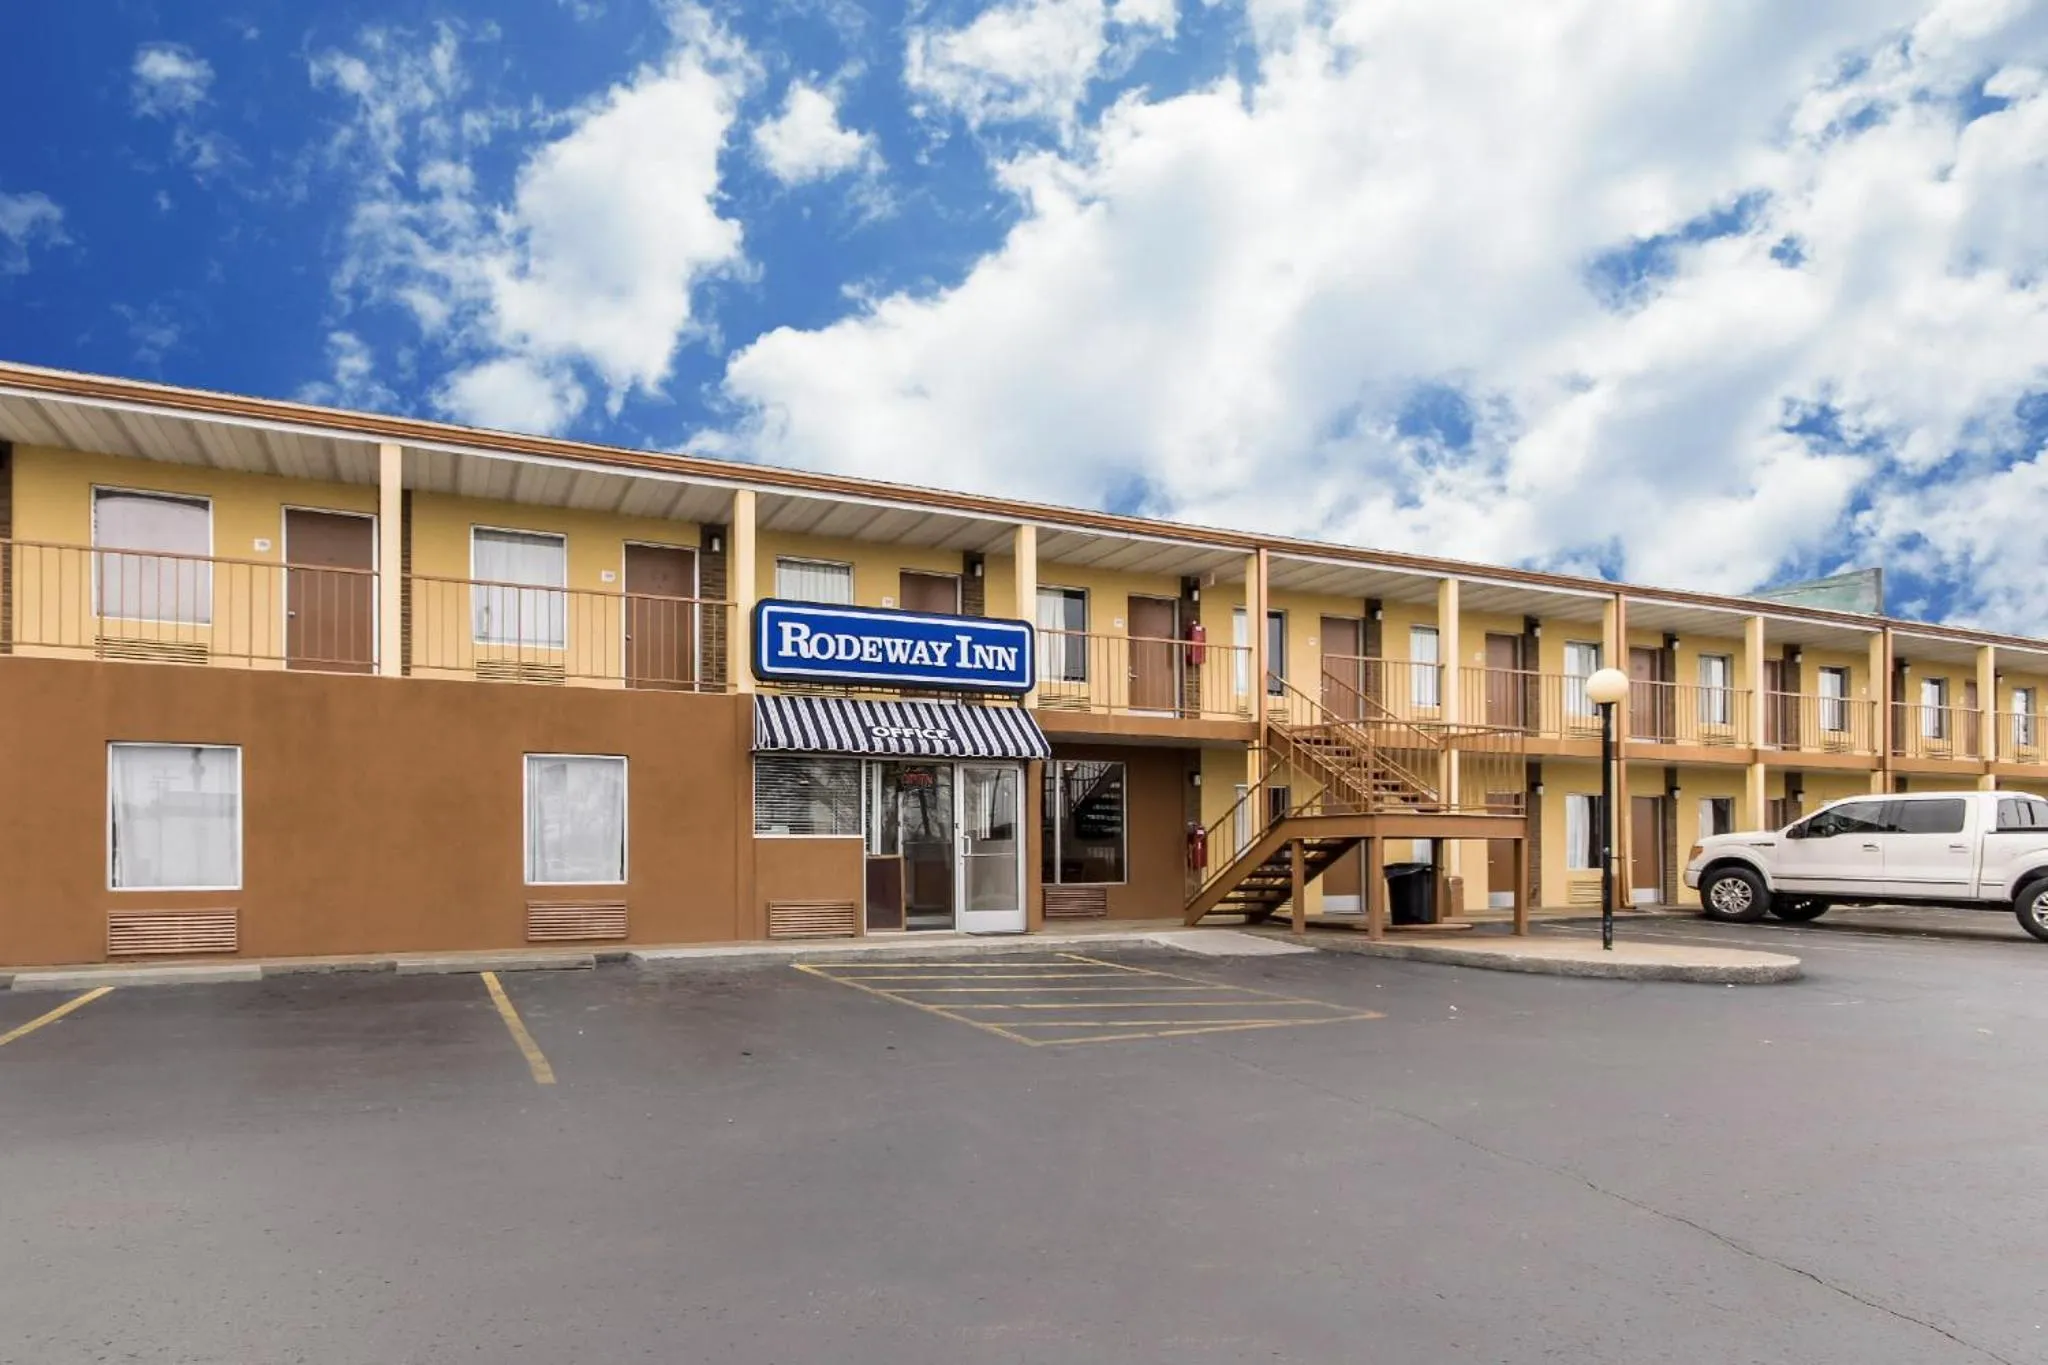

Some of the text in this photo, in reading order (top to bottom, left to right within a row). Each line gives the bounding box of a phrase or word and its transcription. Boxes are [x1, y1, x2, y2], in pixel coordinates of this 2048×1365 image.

[778, 622, 1018, 671] RODEWAY INN
[872, 726, 951, 740] OFFICE
